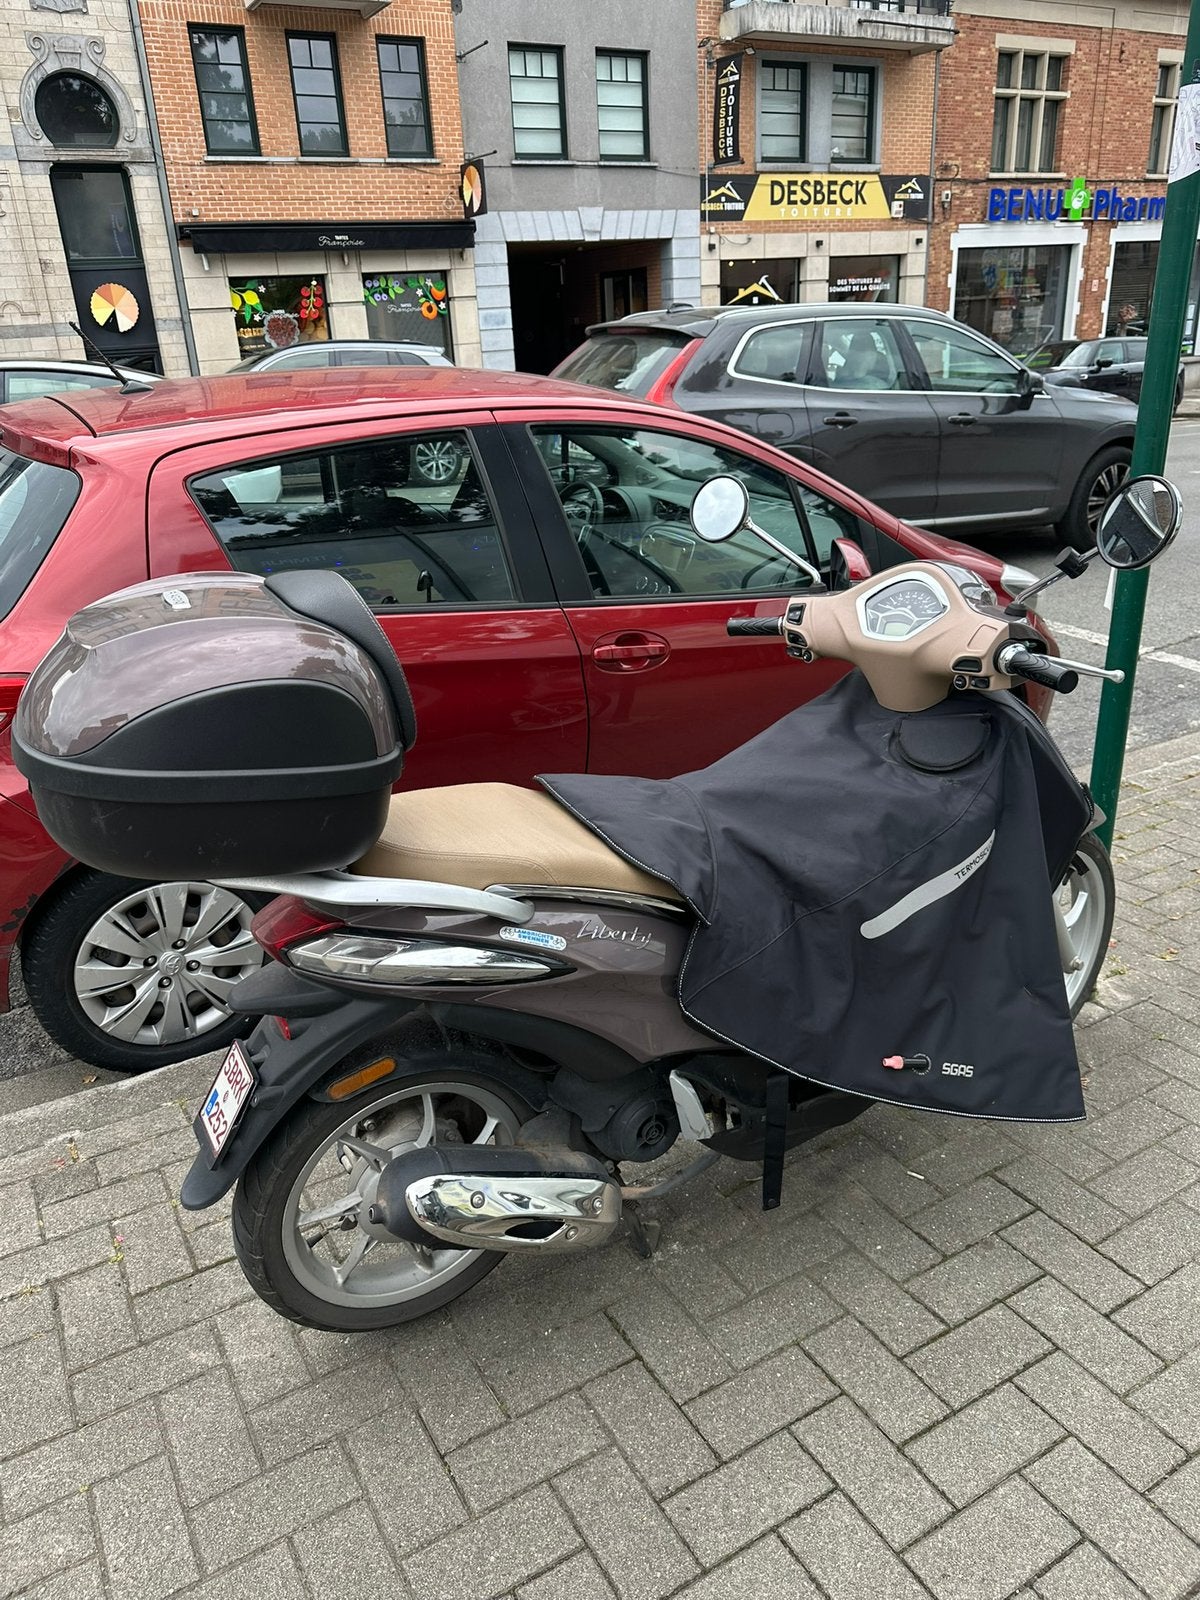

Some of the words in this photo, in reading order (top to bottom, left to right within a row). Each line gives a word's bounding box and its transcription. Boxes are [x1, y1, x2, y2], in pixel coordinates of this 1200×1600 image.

[718, 87, 728, 158] DESBECK
[726, 84, 735, 157] TOITURE
[770, 180, 867, 205] DESBECK
[988, 189, 1064, 221] BENU
[780, 208, 852, 217] TOITURE
[576, 920, 652, 950] Liberty
[224, 1053, 248, 1104] SBRK
[942, 1062, 974, 1077] SGAS
[208, 1101, 227, 1145] 252
